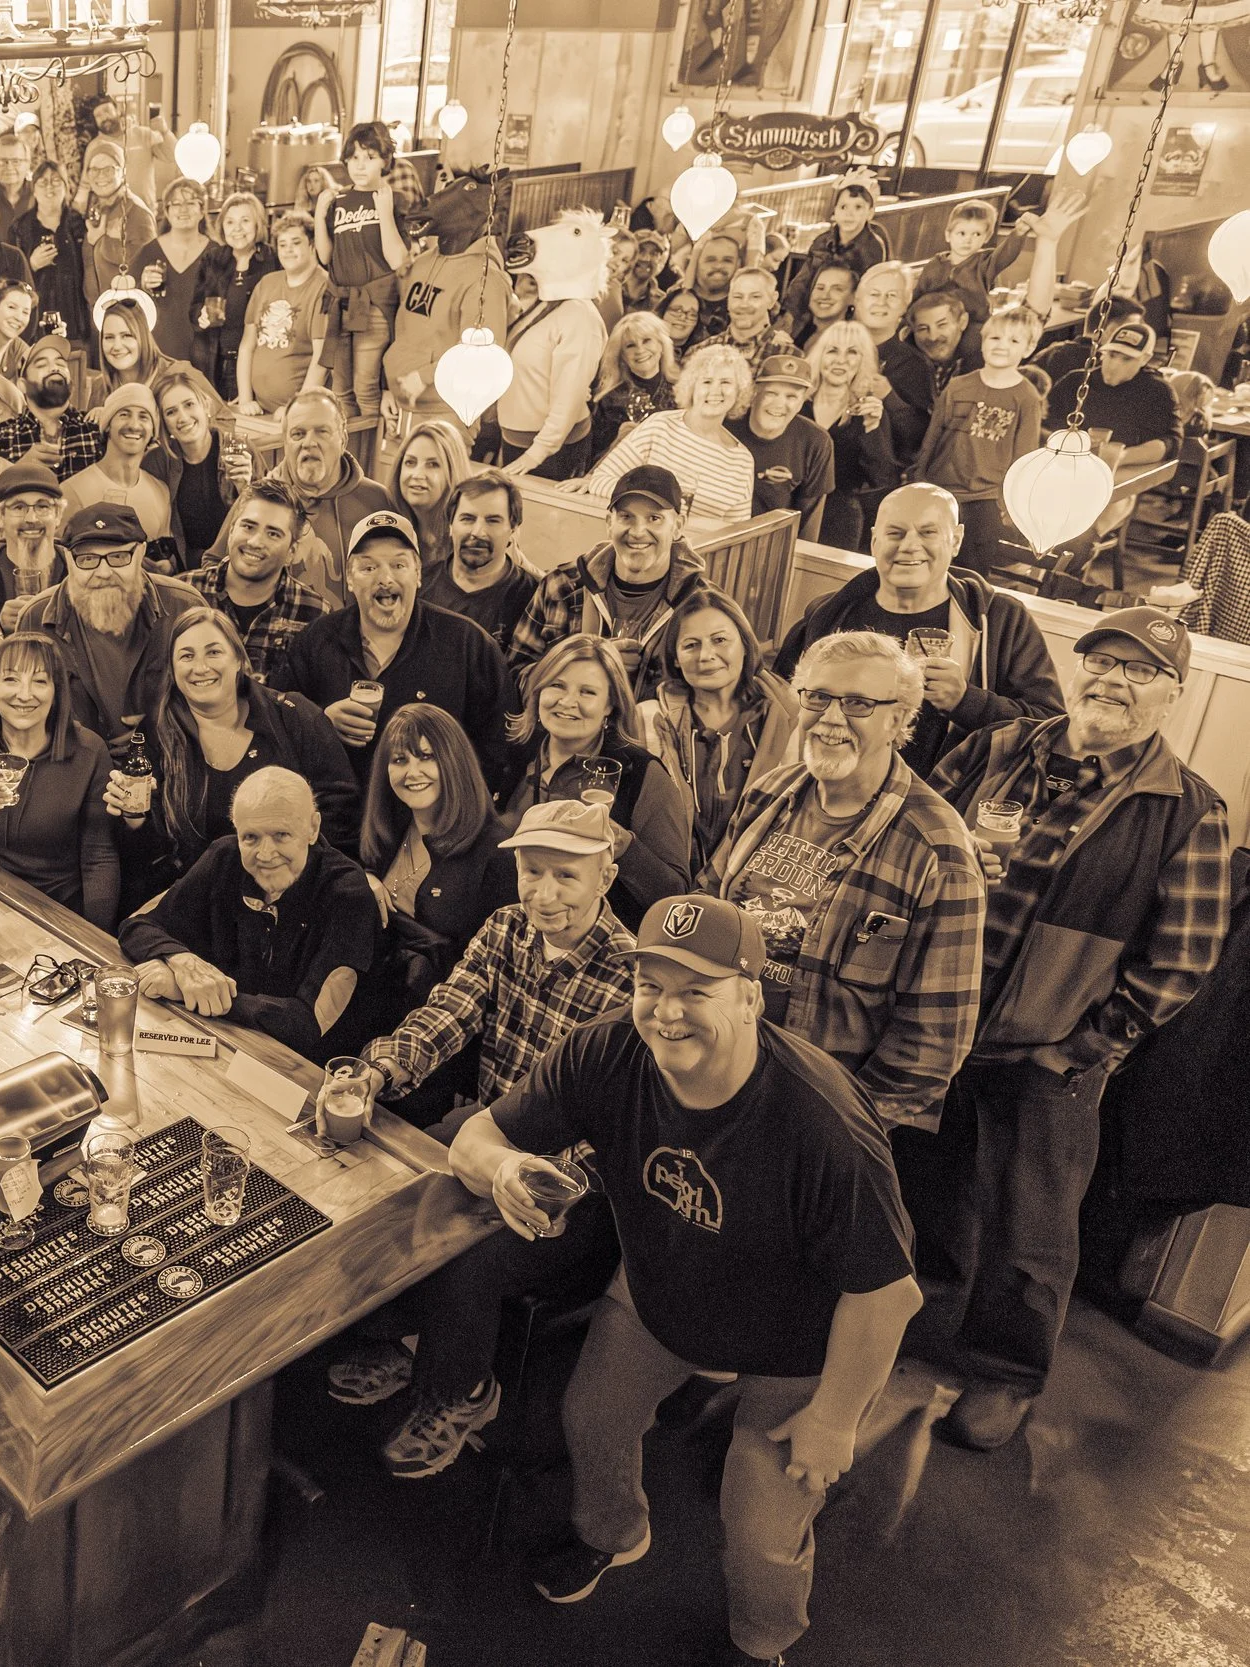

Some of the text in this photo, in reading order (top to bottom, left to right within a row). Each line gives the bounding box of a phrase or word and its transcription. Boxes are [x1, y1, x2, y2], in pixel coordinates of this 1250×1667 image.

[725, 124, 841, 149] Stammtisch
[334, 205, 380, 232] Dodger
[405, 281, 443, 318] CAT
[760, 832, 838, 878] ATTL
[744, 851, 828, 901] GROUN
[139, 1031, 212, 1046] RESERVED FOR LEE
[682, 1149, 692, 1159] 12
[130, 1166, 204, 1209] DESCHUTE
[203, 1216, 285, 1267] DESCHUTES
[222, 1229, 284, 1267] BREWERY
[9, 1244, 78, 1282] BREWERY
[23, 1261, 113, 1314] DESCHUTES
[44, 1274, 112, 1315] BREWERY
[58, 1292, 149, 1348] DESCHUTES
[80, 1306, 148, 1349] BREWERY
